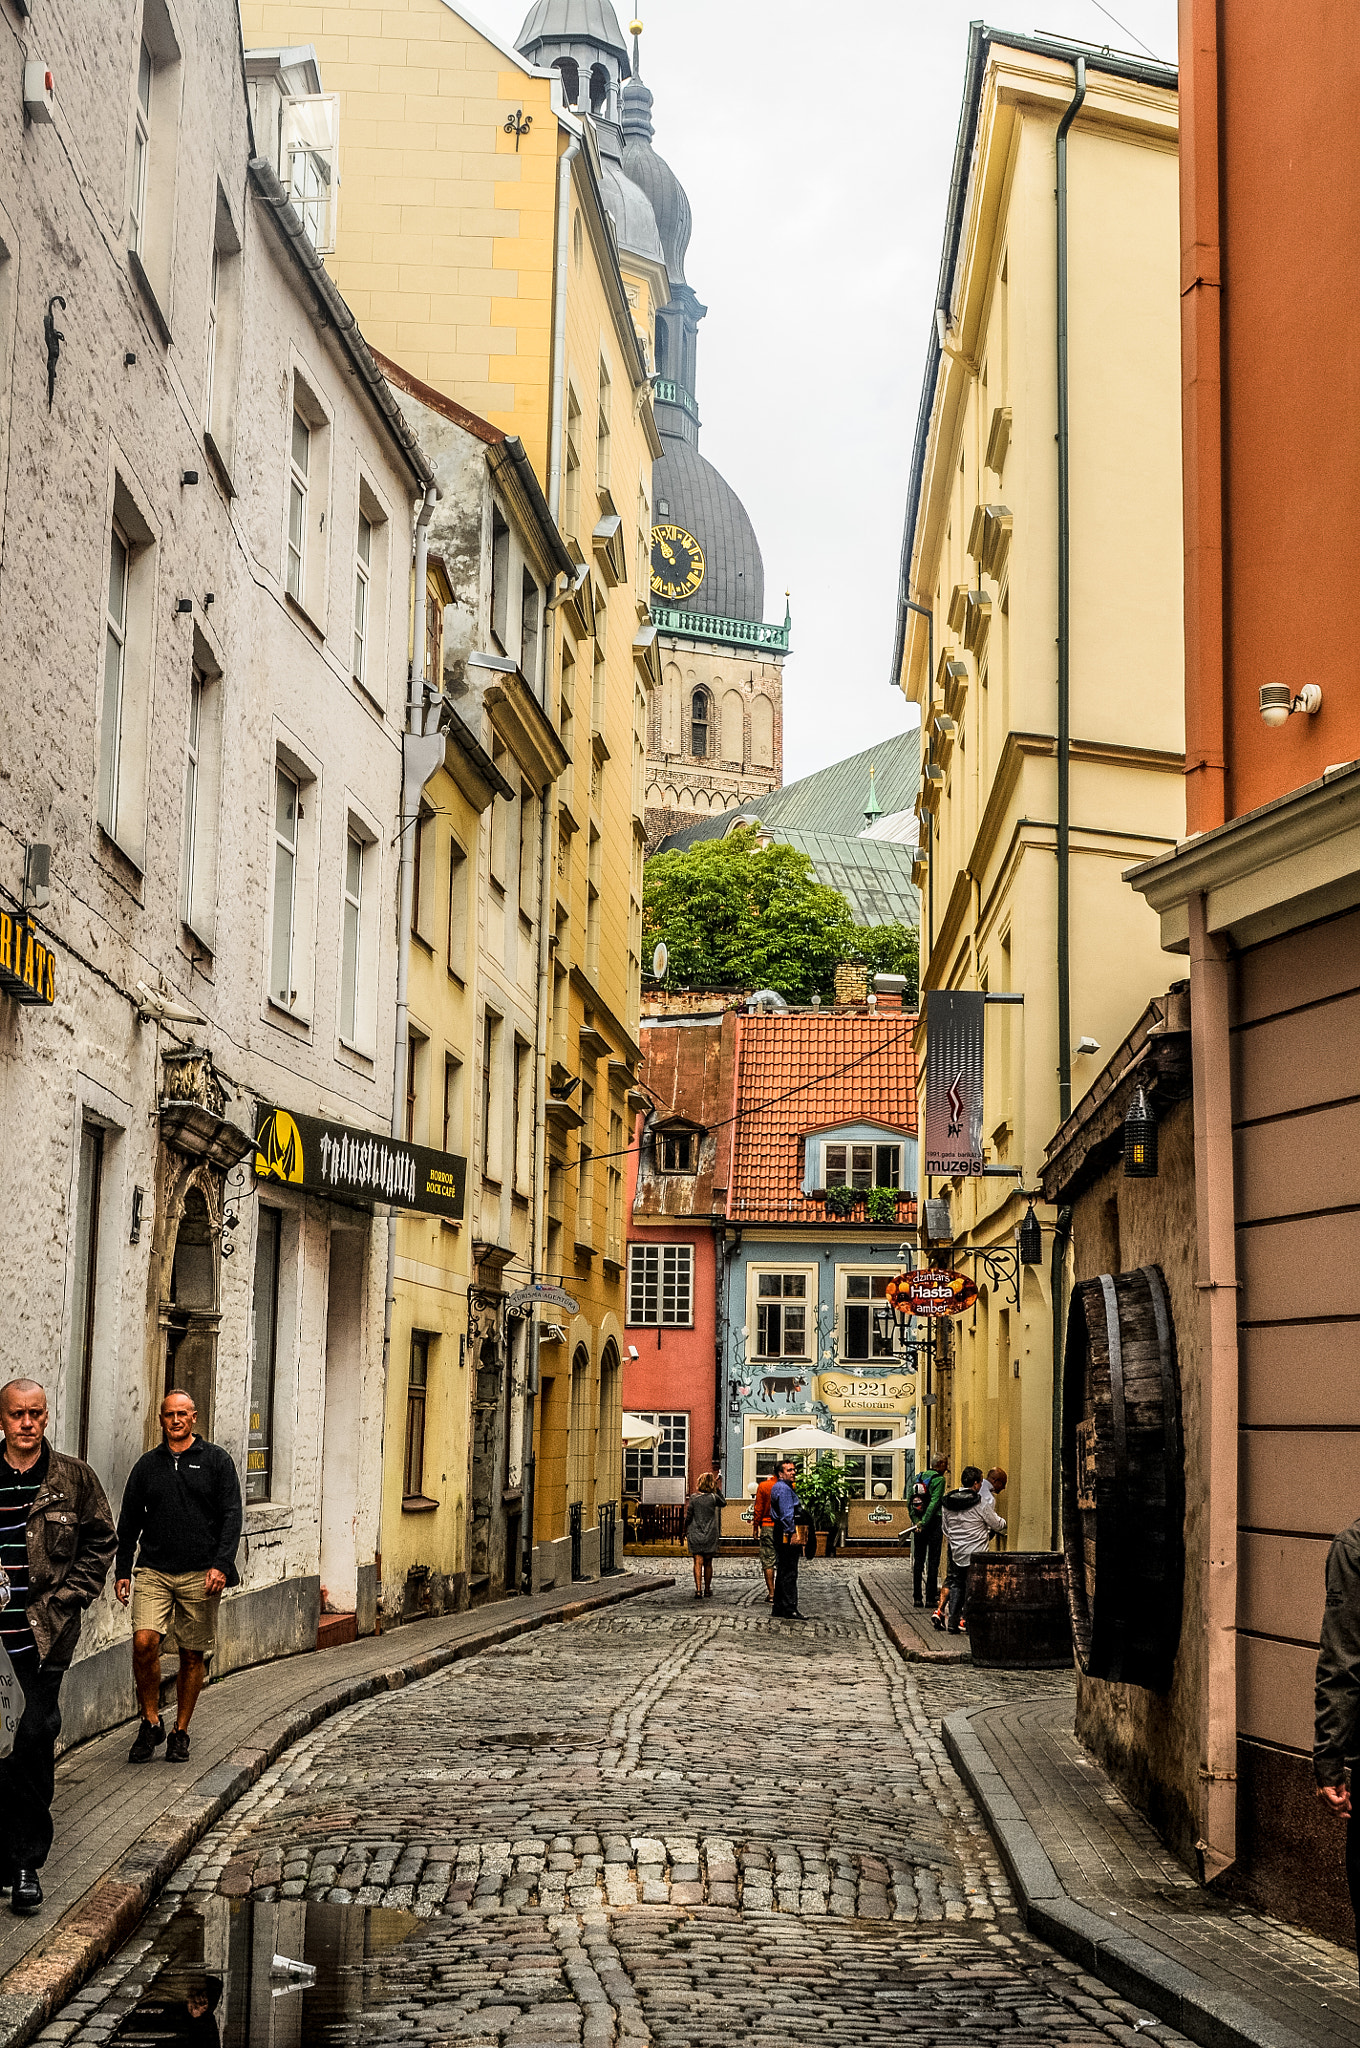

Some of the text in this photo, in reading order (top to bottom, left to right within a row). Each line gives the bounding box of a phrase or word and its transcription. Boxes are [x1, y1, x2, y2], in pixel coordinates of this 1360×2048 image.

[320, 1132, 416, 1203] TRANSILVANIA
[926, 1158, 981, 1176] muzejs
[430, 1169, 454, 1184] HORROR
[426, 1181, 456, 1198] ROCK CAFÉ
[910, 1285, 953, 1298] Hasta
[916, 1300, 949, 1314] amber
[850, 1381, 887, 1397] 1221
